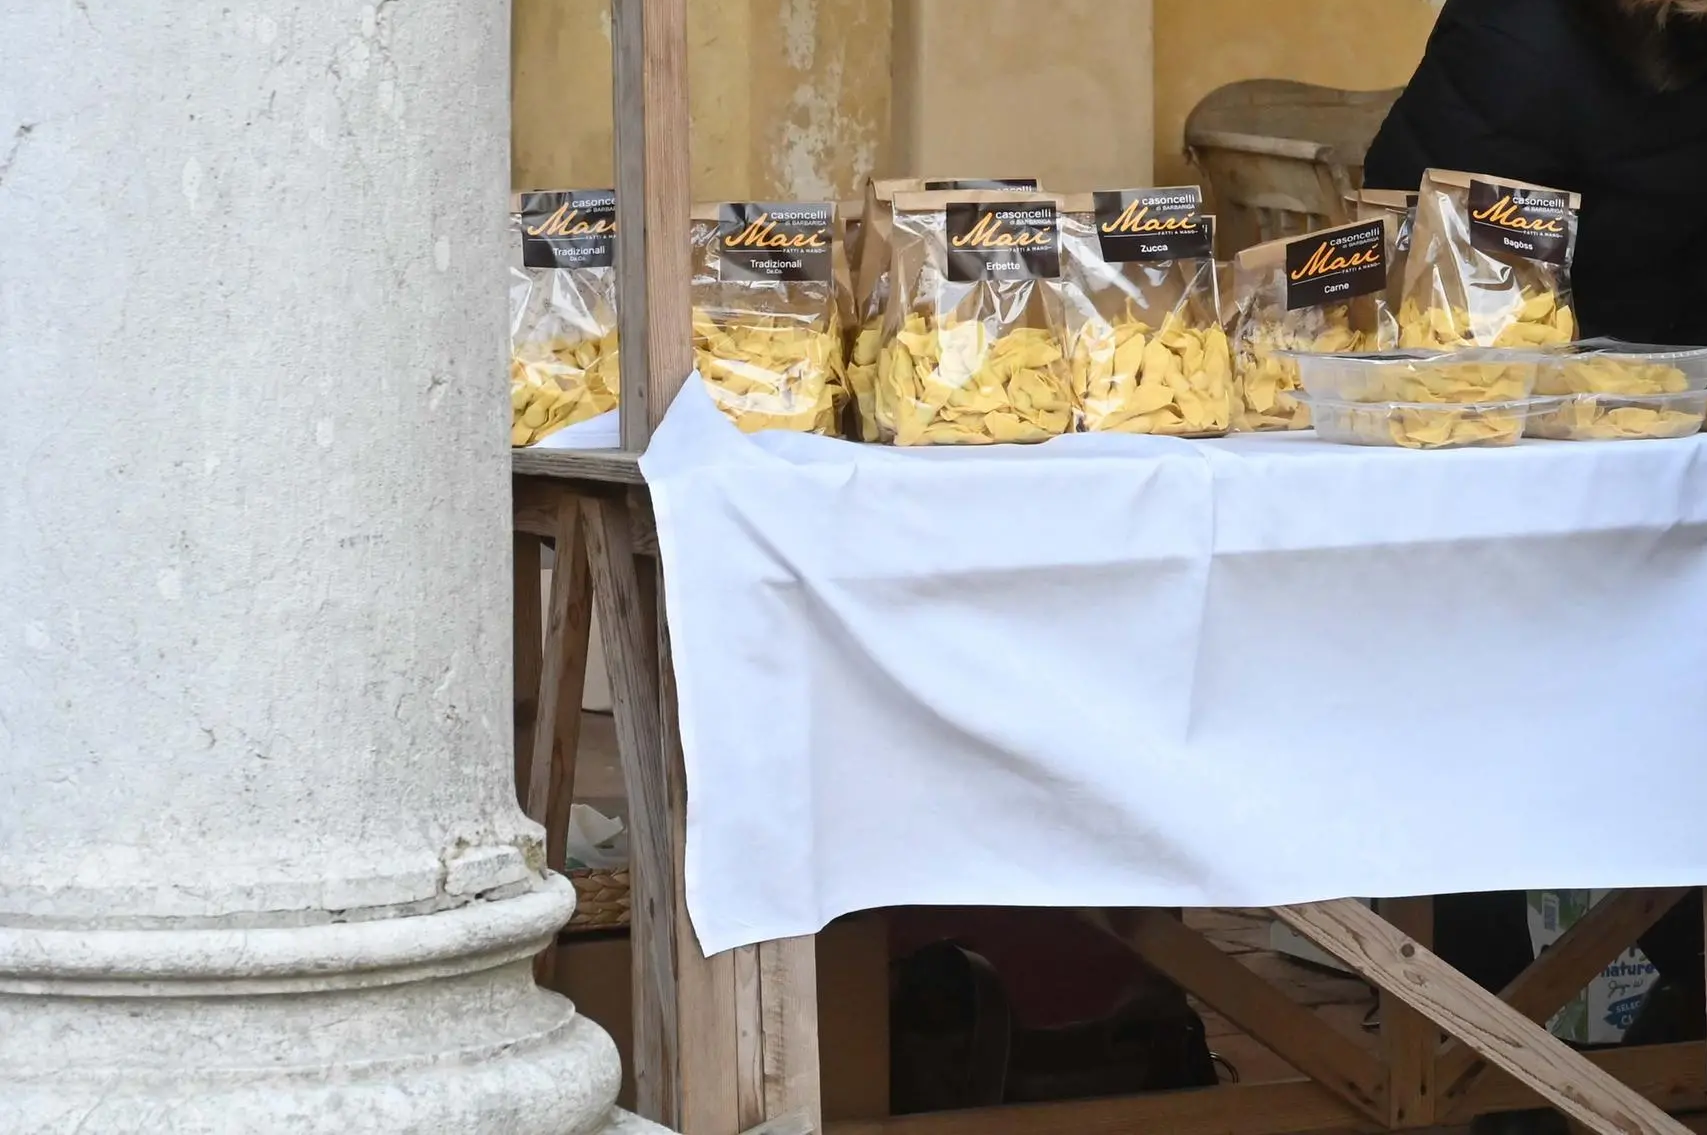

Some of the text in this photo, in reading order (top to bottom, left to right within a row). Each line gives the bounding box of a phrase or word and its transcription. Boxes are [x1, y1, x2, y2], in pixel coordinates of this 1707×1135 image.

[1142, 194, 1195, 205] casoncelli
[1512, 196, 1565, 208] casoncelli
[771, 211, 827, 219] casoncelli
[995, 209, 1051, 219] casoncelli
[1330, 227, 1380, 246] casoncelli
[553, 246, 605, 256] Tradizionali
[1140, 243, 1168, 253] Zucca
[750, 259, 802, 268] Tradizionali
[986, 262, 1020, 270] Erbette
[1324, 283, 1350, 294] Carne
